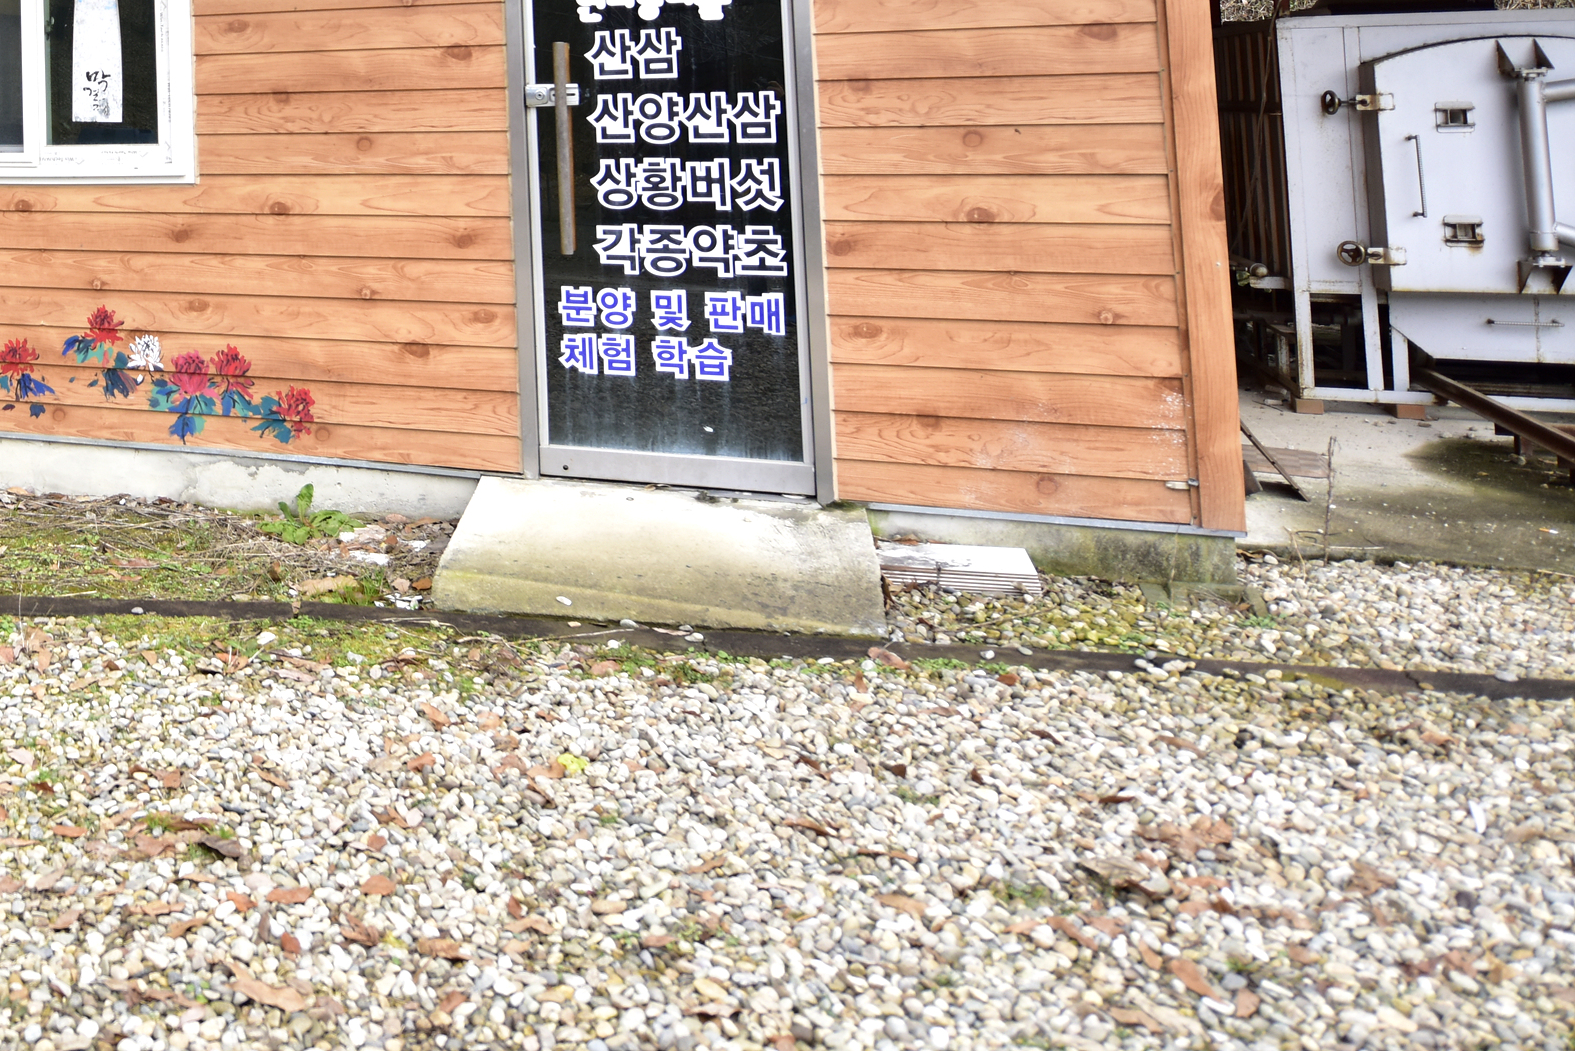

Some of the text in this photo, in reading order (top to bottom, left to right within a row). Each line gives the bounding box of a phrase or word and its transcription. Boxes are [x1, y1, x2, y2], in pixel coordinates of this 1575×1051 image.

[585, 28, 682, 79] 산삼
[587, 91, 781, 143] 산양산삼
[591, 158, 784, 211] 상황버섯
[593, 224, 787, 277] 각종약초
[558, 286, 786, 336] 분양 및 판매
[558, 333, 732, 381] 체험 학습
